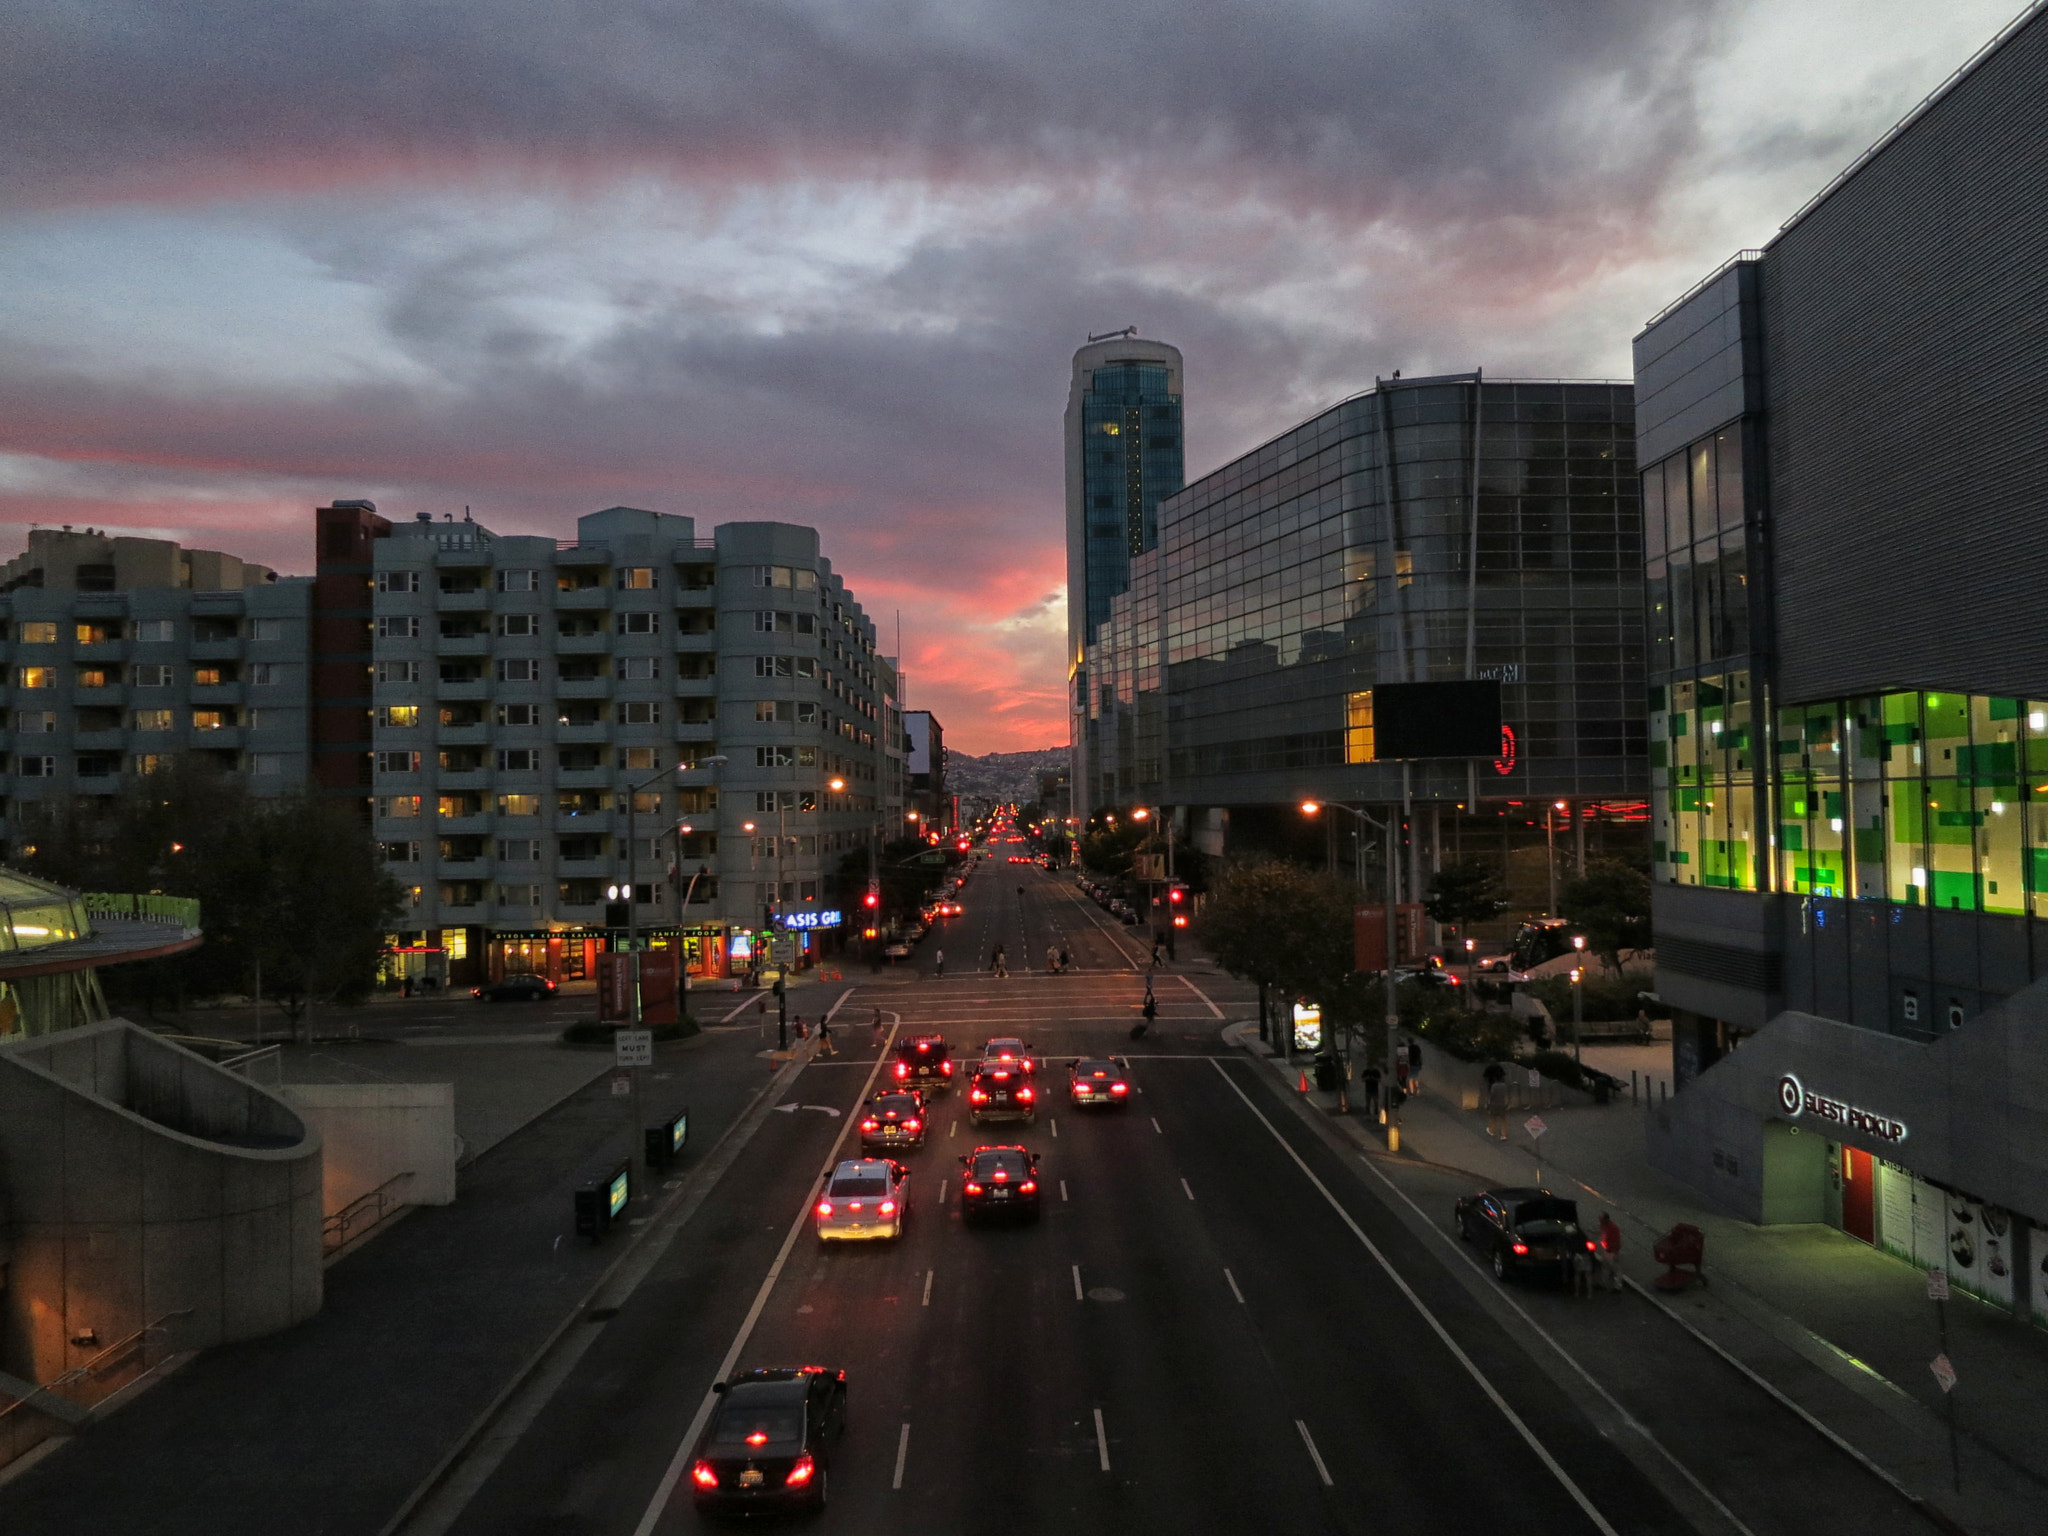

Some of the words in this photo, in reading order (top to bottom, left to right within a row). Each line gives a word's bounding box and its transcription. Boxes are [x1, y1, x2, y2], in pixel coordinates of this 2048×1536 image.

[622, 1043, 647, 1053] MUST
[1804, 1091, 1847, 1123] GUEST
[1848, 1107, 1905, 1142] PICKUP
